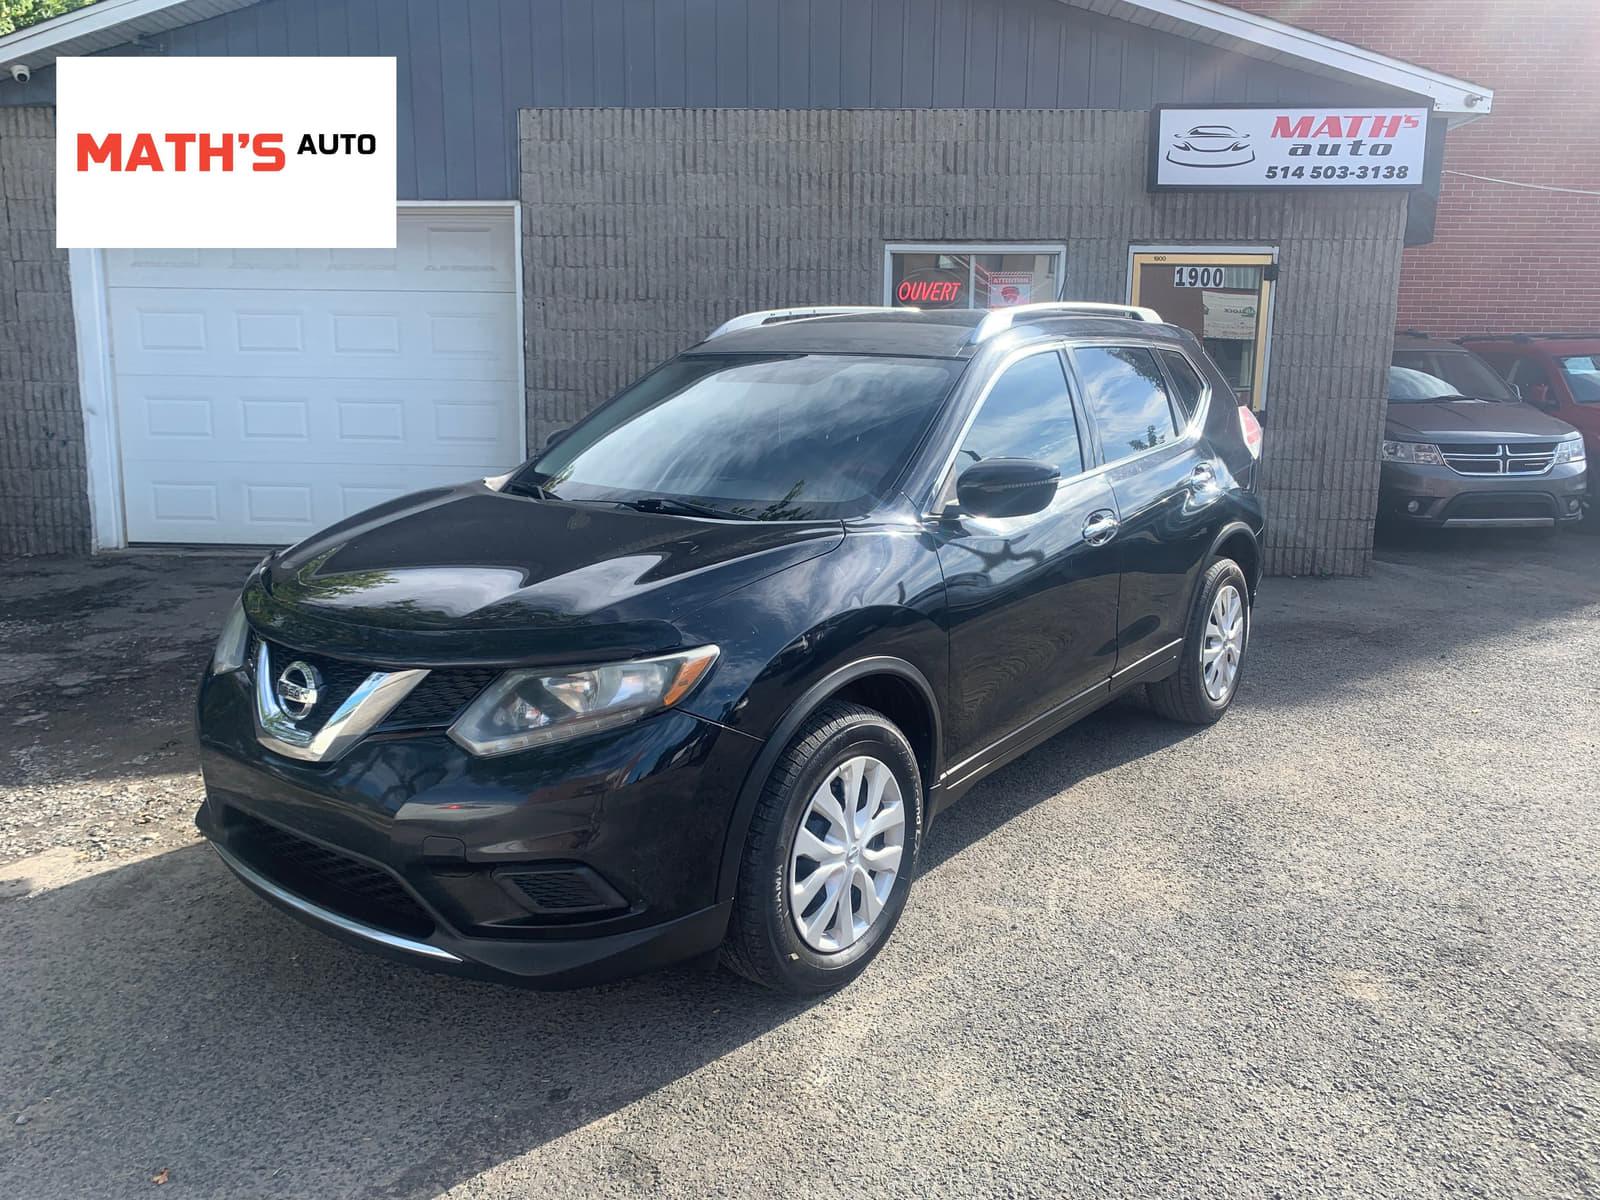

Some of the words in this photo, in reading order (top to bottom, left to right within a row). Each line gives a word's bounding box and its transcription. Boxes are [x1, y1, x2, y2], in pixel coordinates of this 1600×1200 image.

[1289, 139, 1393, 157] auto
[1265, 165, 1304, 179] 514
[1309, 165, 1409, 179] 503-3138
[1175, 267, 1223, 287] 1900
[898, 281, 961, 301] OUVERT
